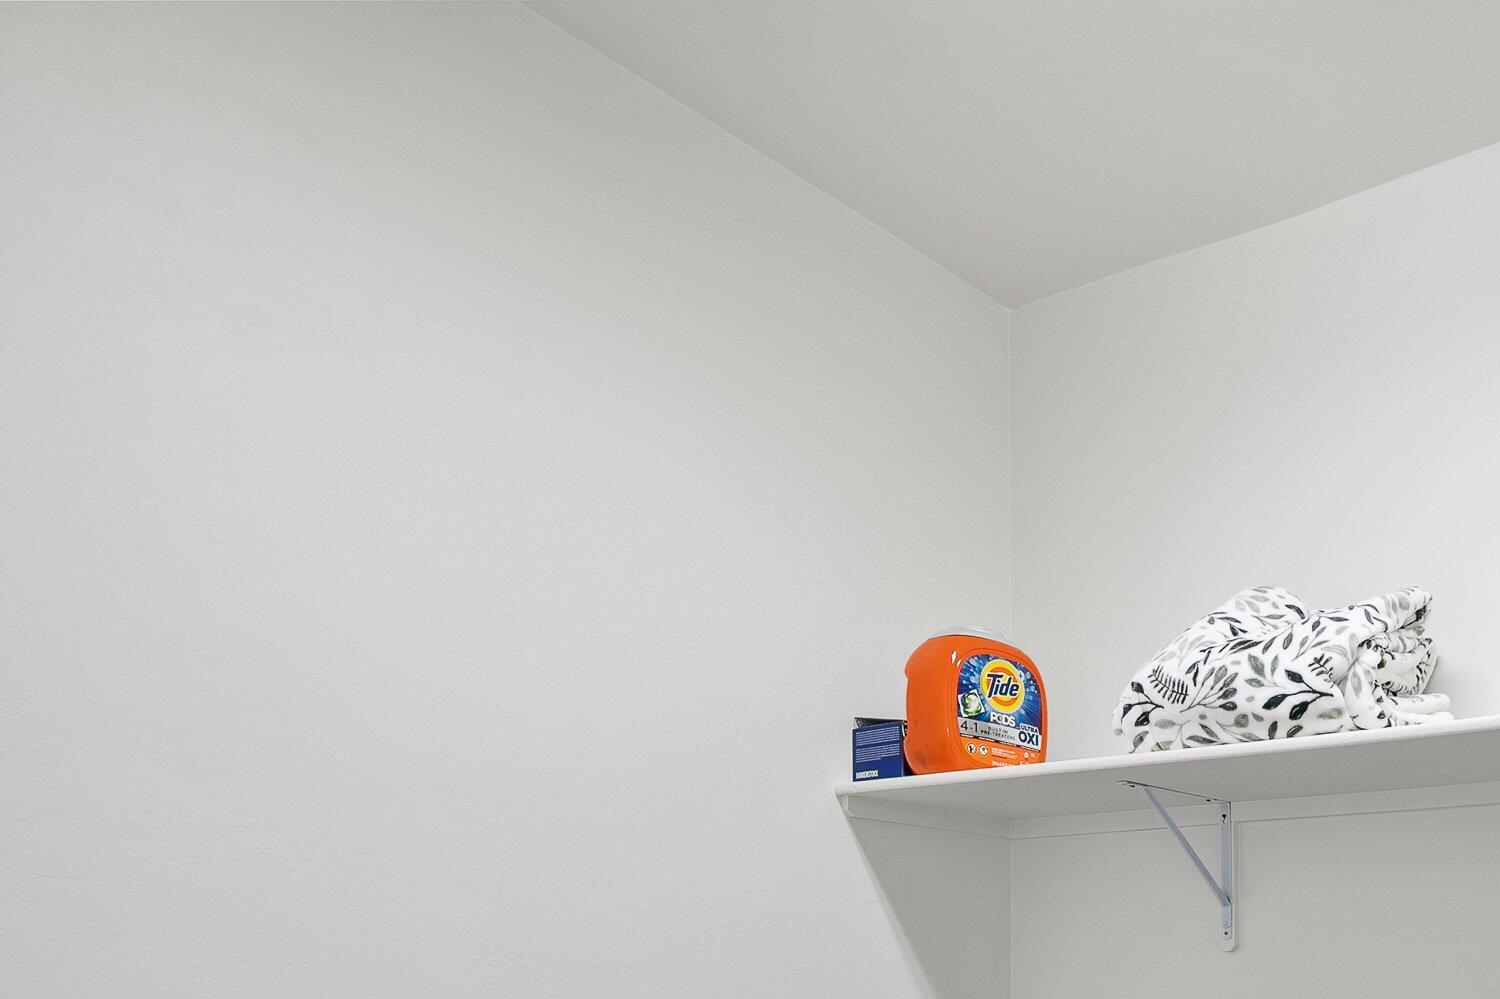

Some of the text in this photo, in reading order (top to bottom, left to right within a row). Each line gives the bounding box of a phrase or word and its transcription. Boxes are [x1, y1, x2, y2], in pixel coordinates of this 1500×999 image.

[986, 673, 1020, 699] Tide
[990, 712, 1016, 726] PODS
[1020, 724, 1038, 733] ULTRA
[1019, 731, 1039, 746] OXI
